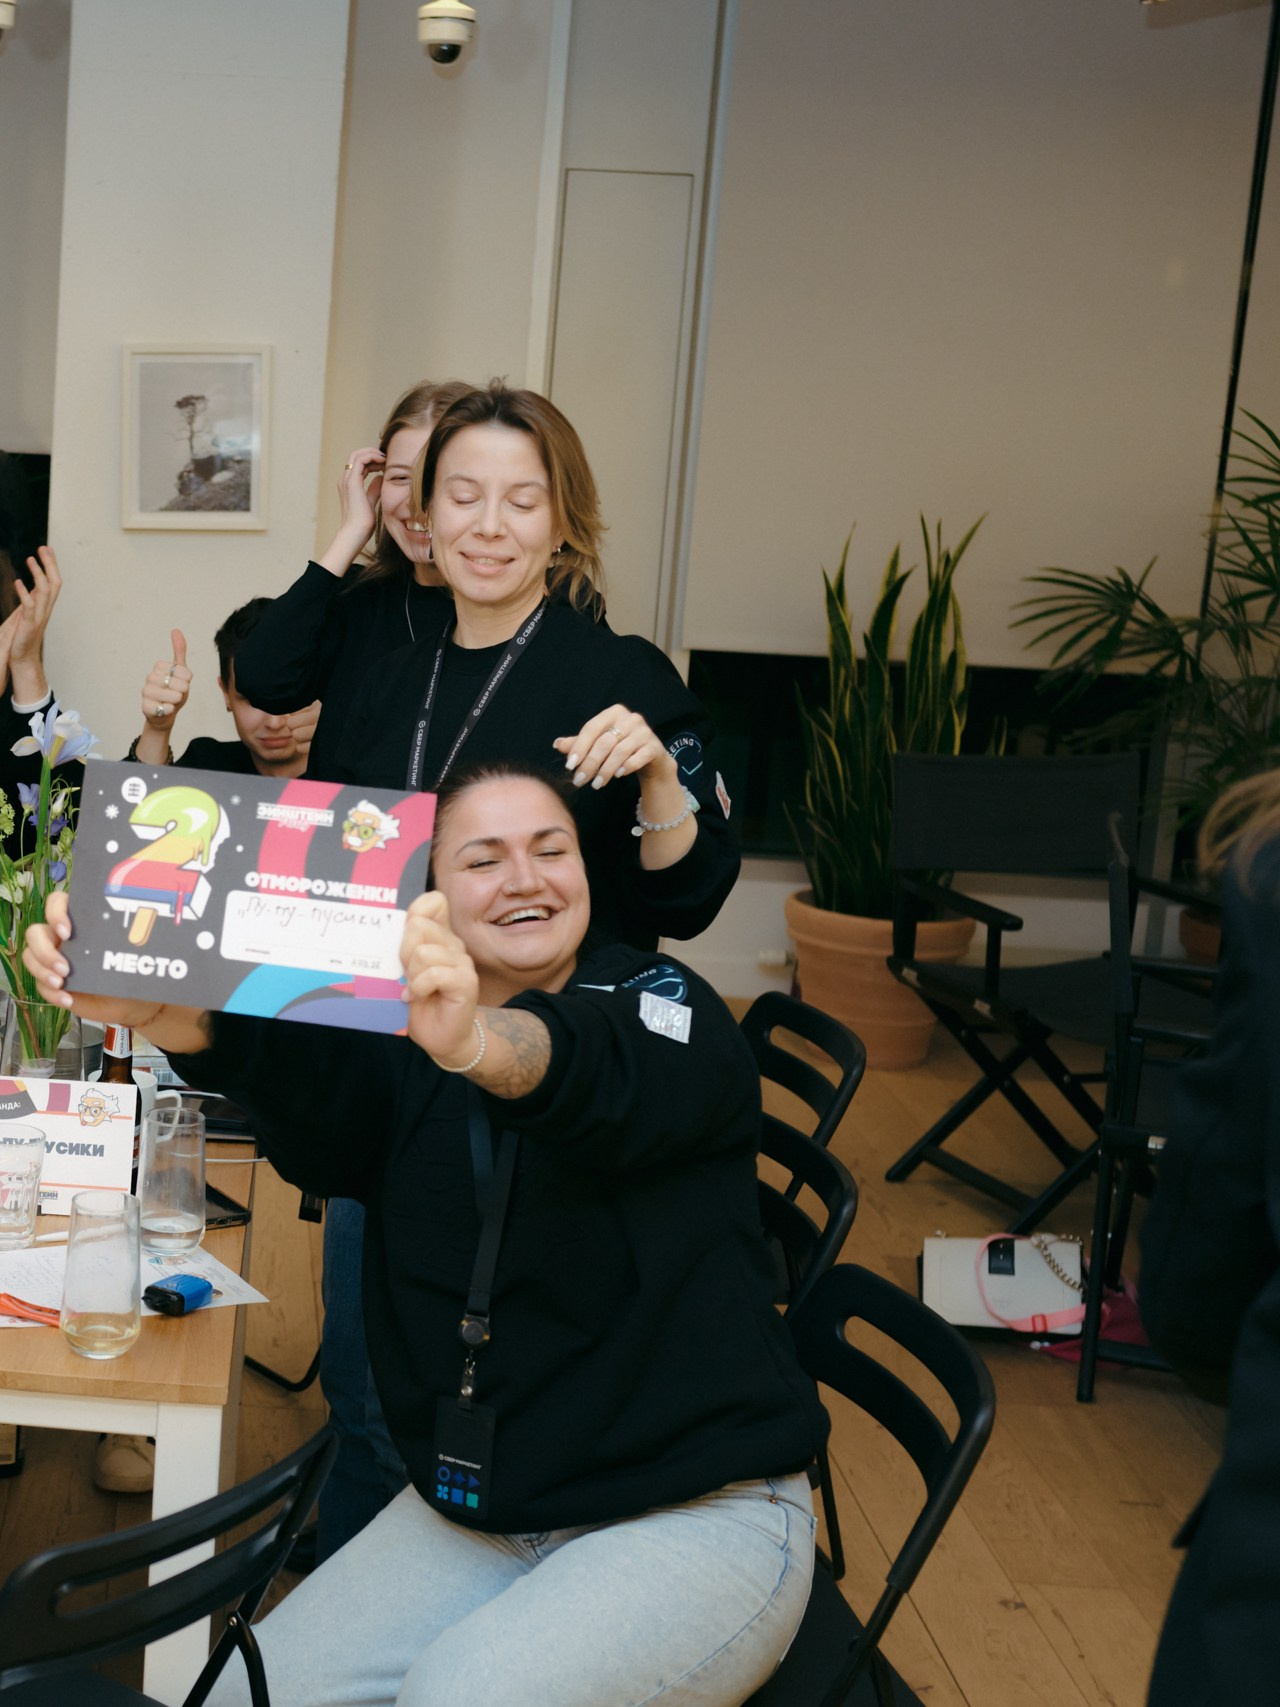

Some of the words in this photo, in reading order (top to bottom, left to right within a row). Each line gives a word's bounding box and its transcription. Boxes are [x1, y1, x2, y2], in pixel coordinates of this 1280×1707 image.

[522, 621, 536, 638] СБЕР
[478, 690, 490, 708] СБЕР
[488, 654, 513, 691] МАРКЕТИНГ
[670, 737, 695, 757] ETING
[410, 746, 421, 787] МАРКЕТИНГ
[245, 871, 398, 904] ОТМОРОЖЕНКИ
[102, 950, 188, 979] МЕСТО
